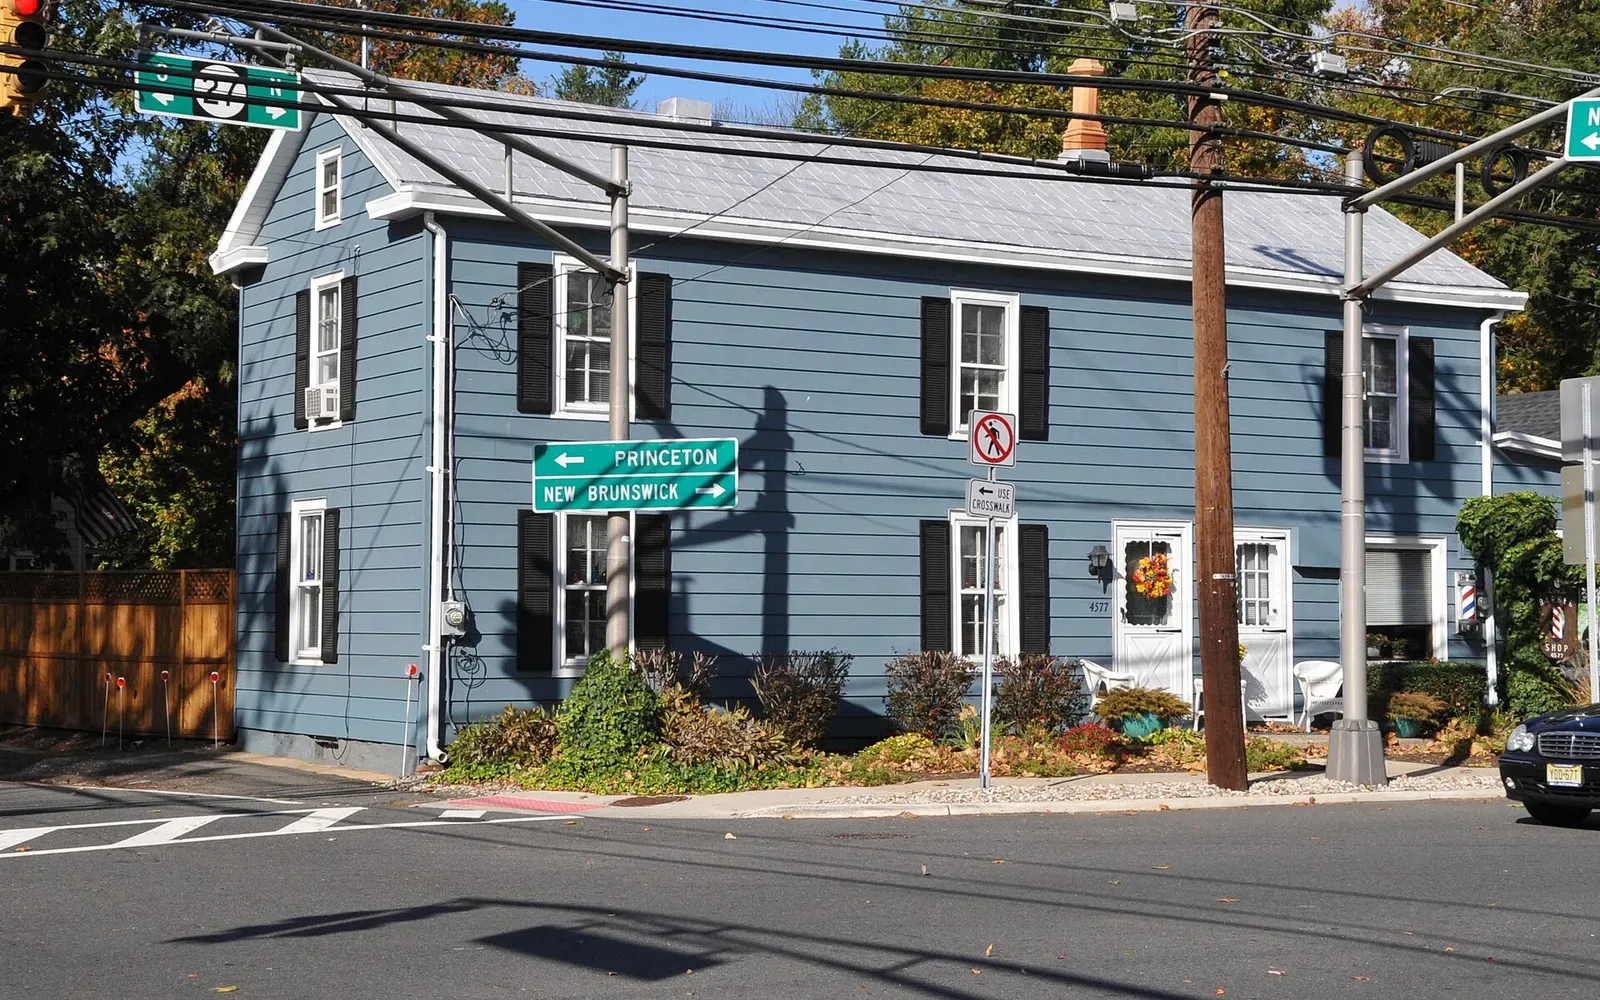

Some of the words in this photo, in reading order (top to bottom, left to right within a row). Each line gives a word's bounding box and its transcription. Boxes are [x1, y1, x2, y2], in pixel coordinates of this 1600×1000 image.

[202, 75, 240, 107] 27
[615, 448, 718, 467] PRINCETON
[544, 485, 576, 502] NEW
[588, 483, 679, 502] BRUNSWICK
[997, 487, 1010, 500] USE
[972, 498, 1010, 513] CROSSWALK
[1089, 601, 1109, 612] 4577
[1545, 643, 1569, 652] SHOP
